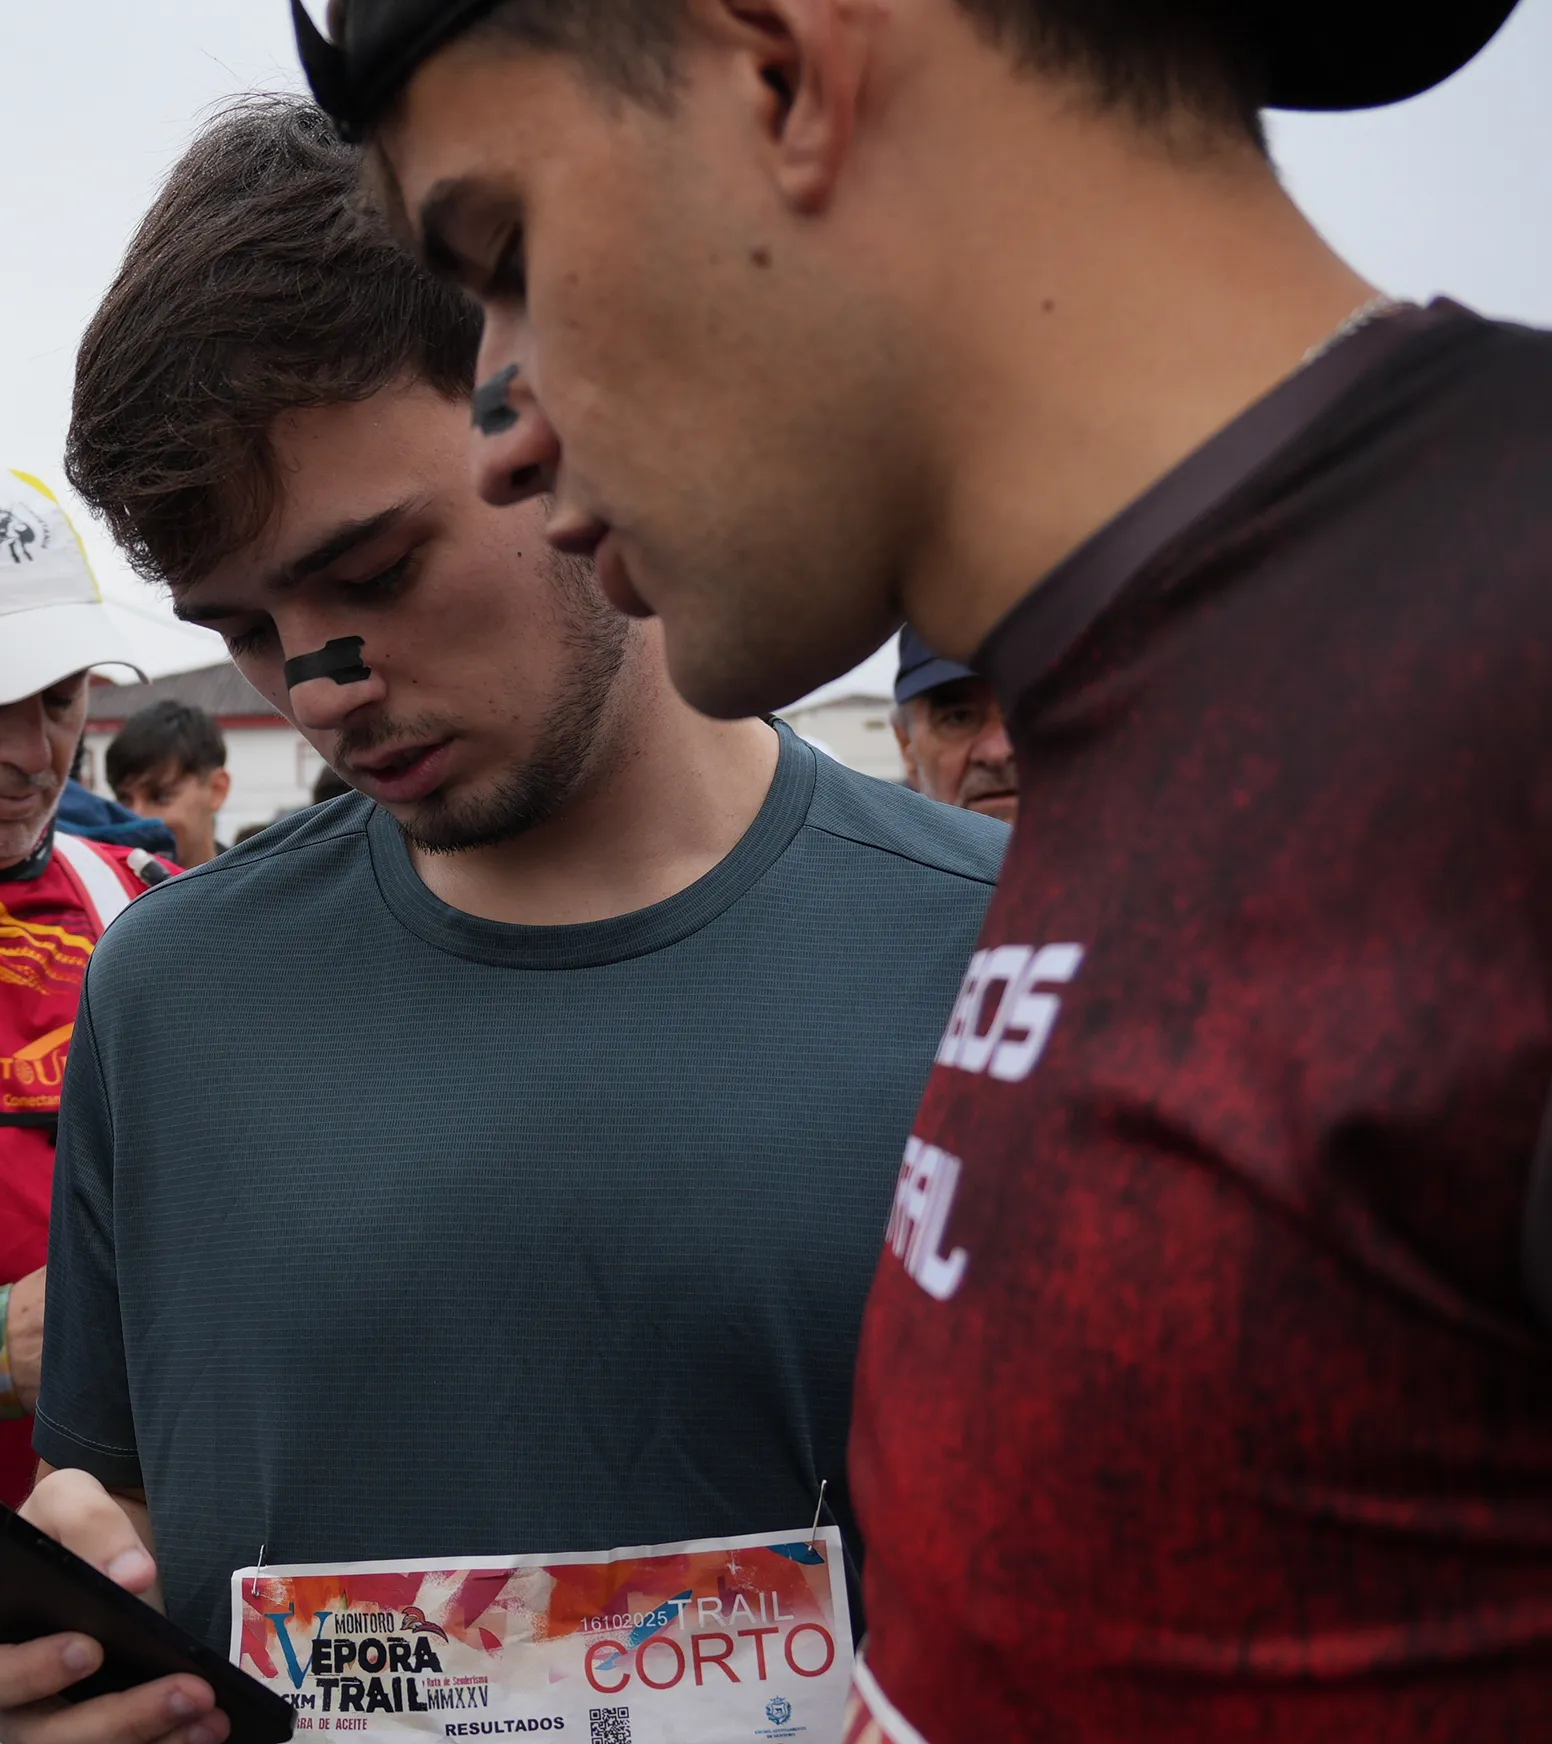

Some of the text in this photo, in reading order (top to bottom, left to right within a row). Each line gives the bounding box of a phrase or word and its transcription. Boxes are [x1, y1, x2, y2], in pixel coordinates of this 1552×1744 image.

[334, 1612, 395, 1635] MONTORO
[580, 1590, 795, 1632] 16102025 TRAIL
[311, 1636, 443, 1675] EPORA
[584, 1622, 836, 1694] CORTO
[316, 1676, 429, 1713] TRAIL
[428, 1685, 489, 1710] MMXXV
[319, 1718, 330, 1730] DE
[336, 1718, 368, 1731] ACEITE
[445, 1716, 565, 1738] RESULTADOS
